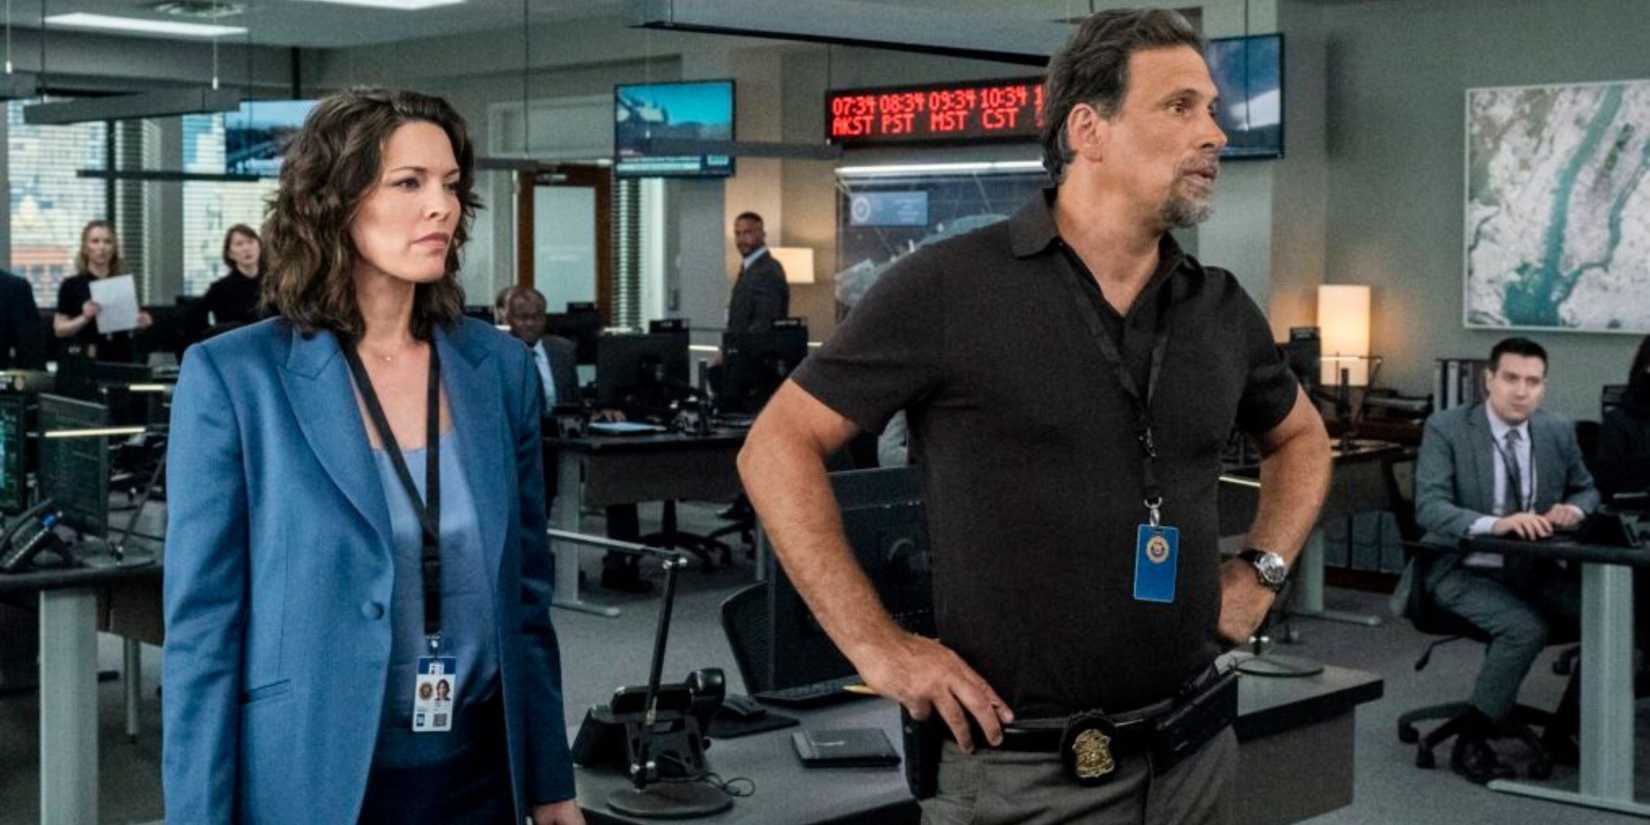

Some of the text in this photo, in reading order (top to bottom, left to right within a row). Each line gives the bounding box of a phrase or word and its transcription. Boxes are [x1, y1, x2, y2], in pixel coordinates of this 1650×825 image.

[832, 96, 876, 115] 07:34
[879, 92, 925, 112] 08:34
[928, 90, 976, 110] 09:34
[980, 85, 1027, 108] 10:34
[832, 115, 873, 136] AKST
[880, 113, 915, 133] PST
[930, 110, 968, 131] MST
[982, 107, 1018, 128] CST
